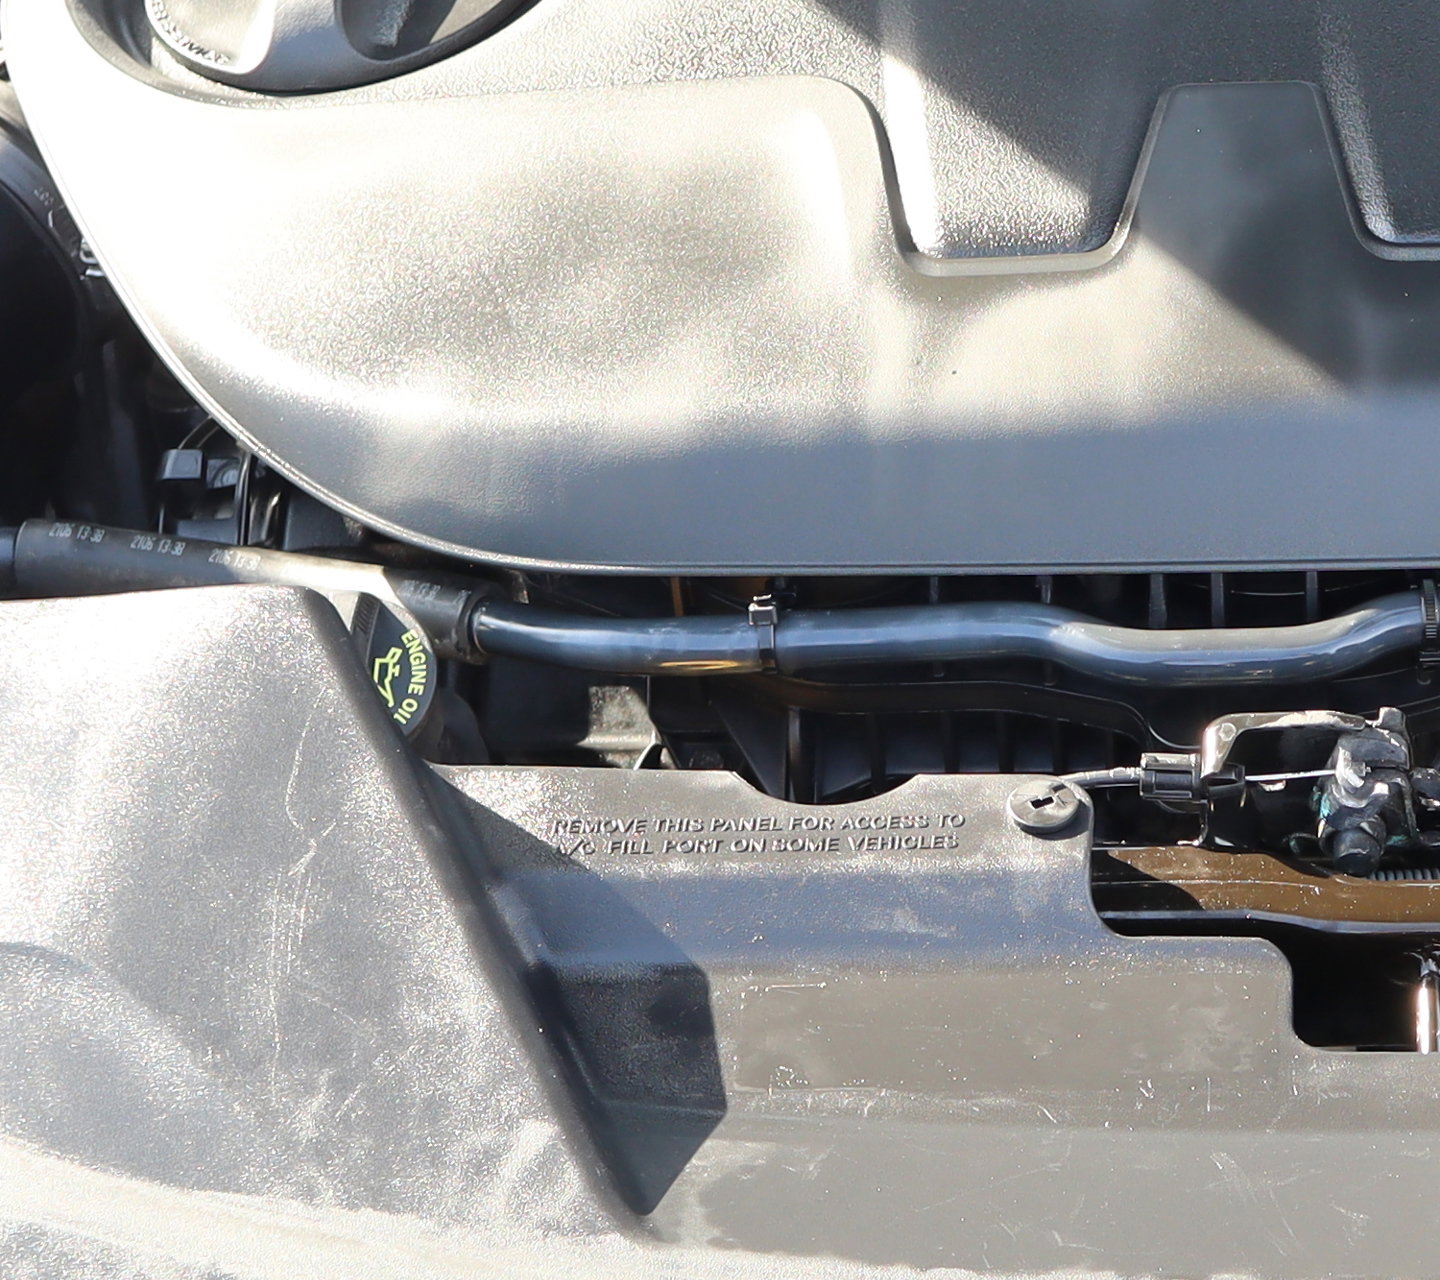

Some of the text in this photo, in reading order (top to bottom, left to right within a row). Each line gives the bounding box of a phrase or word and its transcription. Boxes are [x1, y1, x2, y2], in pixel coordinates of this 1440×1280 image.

[393, 628, 428, 725] ENGINE OIL
[552, 813, 966, 835] REMOVE THIS PANEL FOR ACCESS TO
[607, 838, 654, 855] FILL
[661, 838, 724, 854] PORT
[730, 837, 767, 853] ON
[771, 836, 840, 852] SOME
[847, 834, 960, 851] VEHICLES
